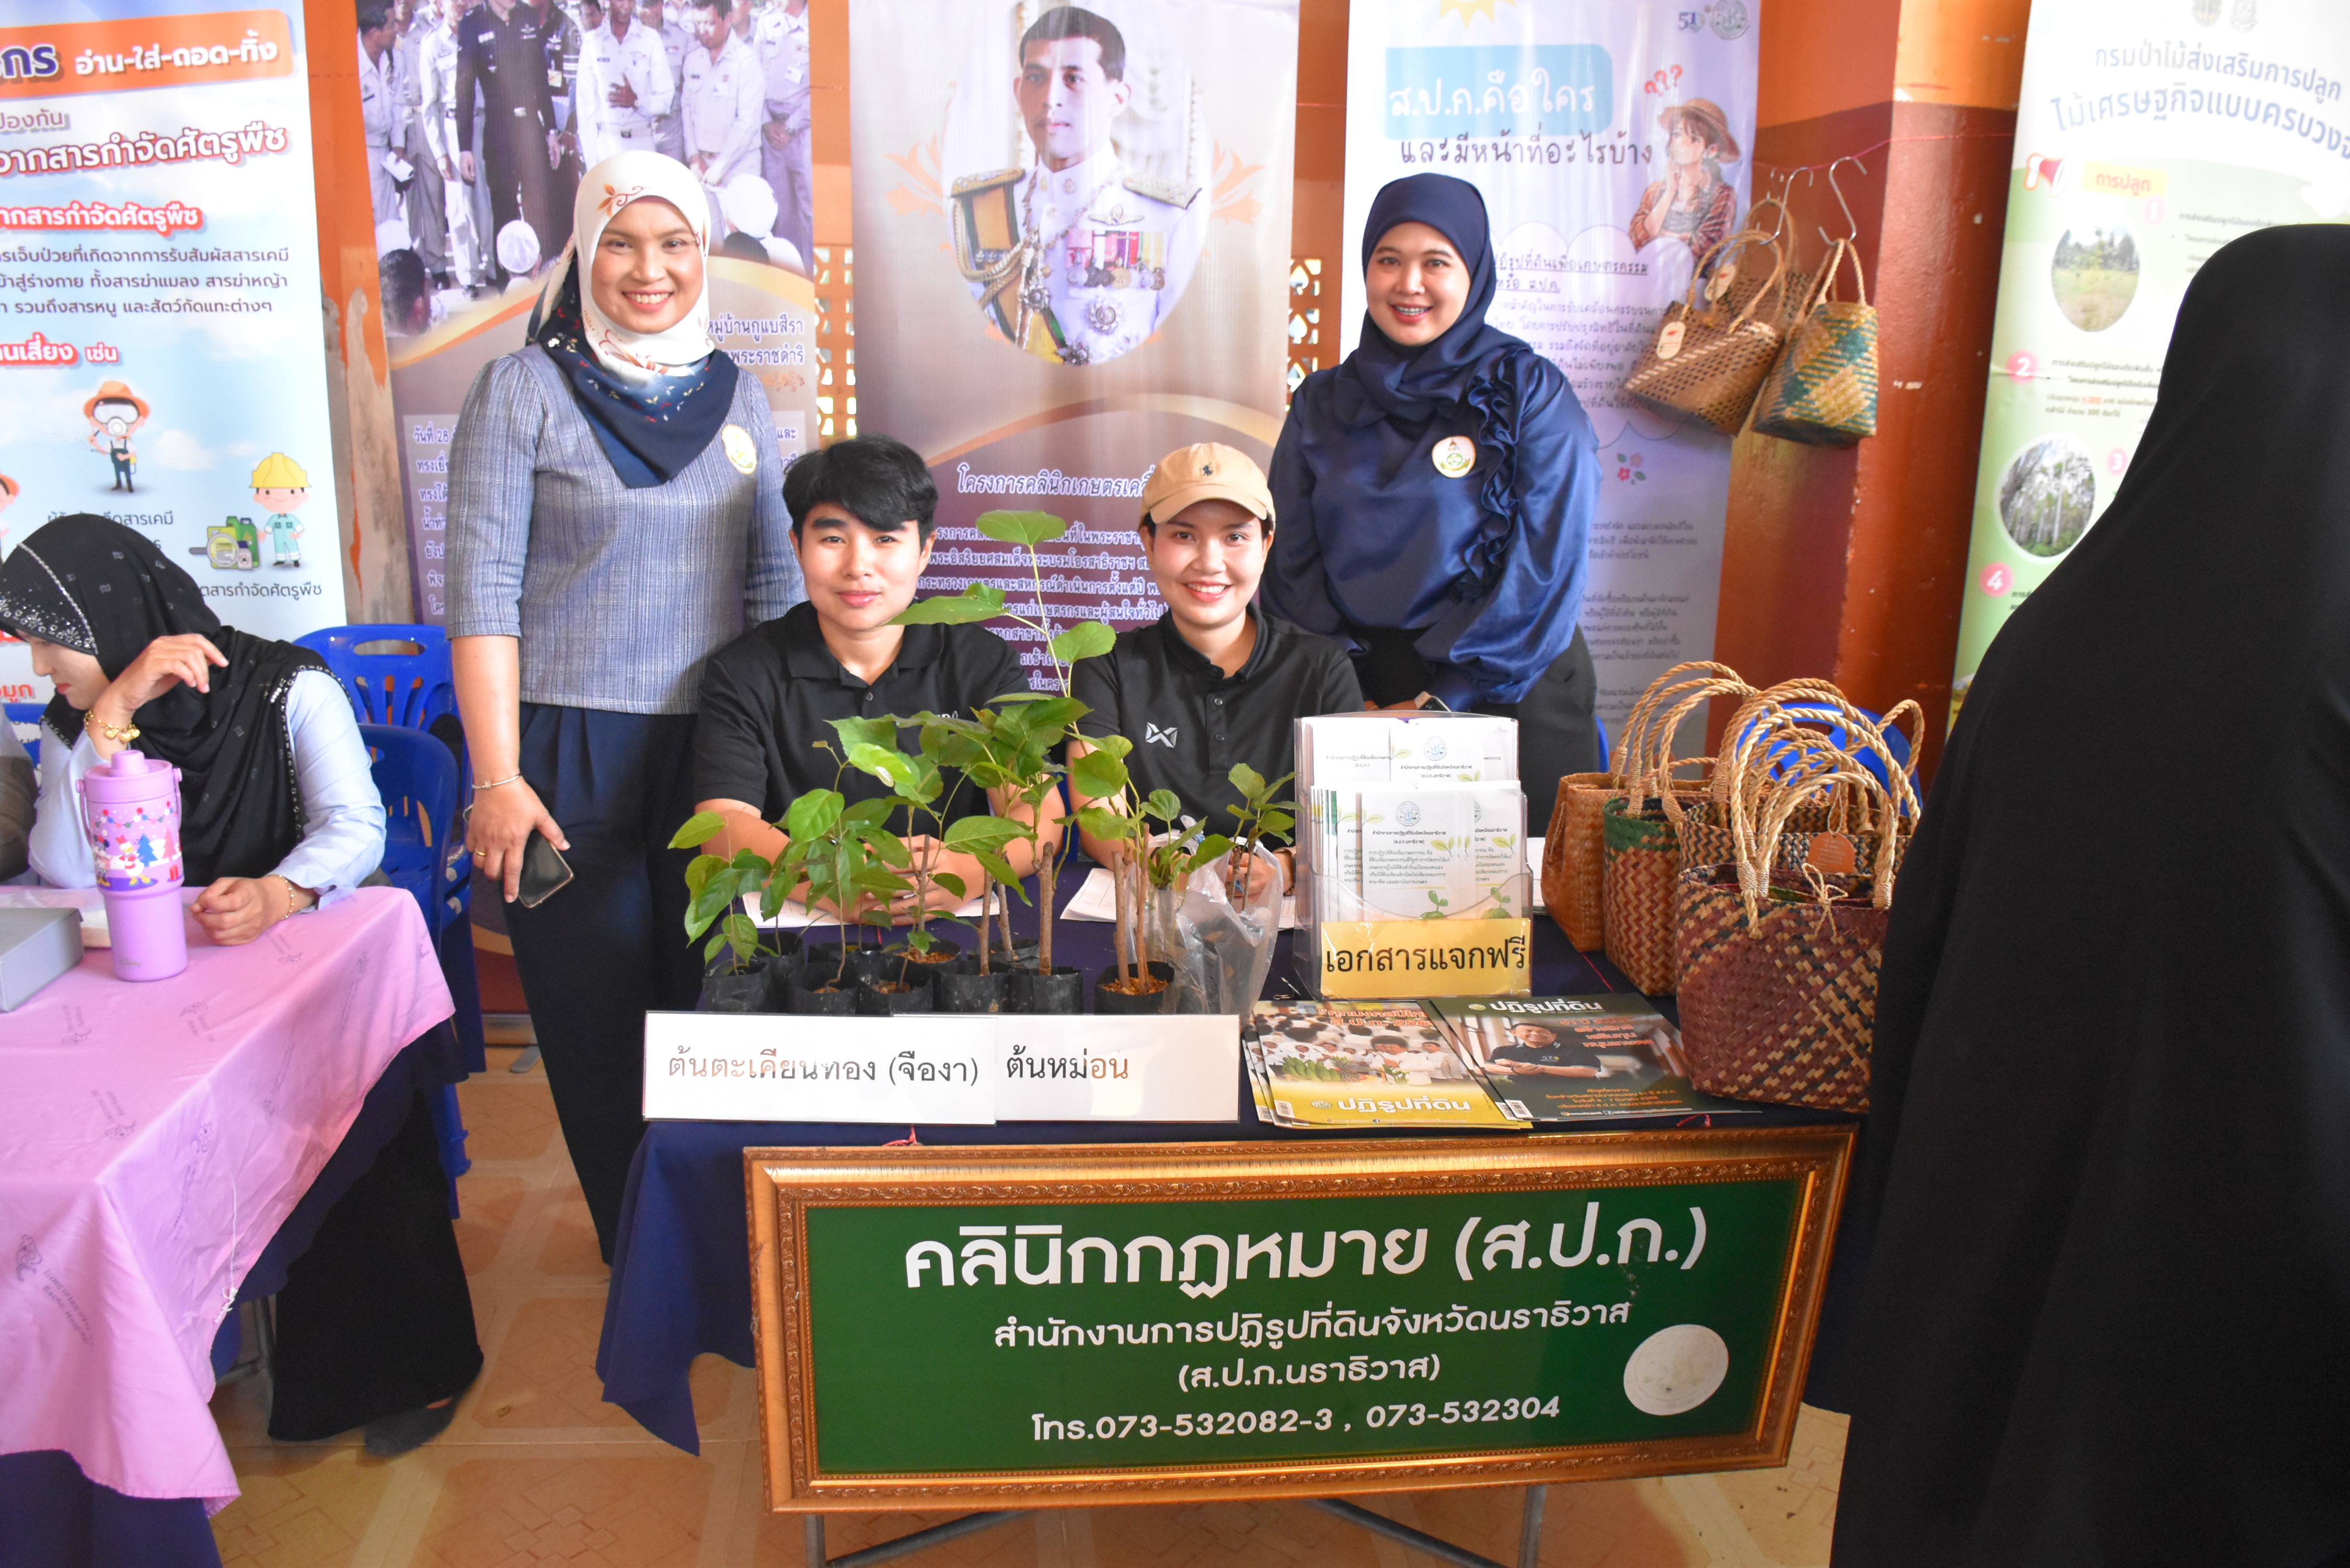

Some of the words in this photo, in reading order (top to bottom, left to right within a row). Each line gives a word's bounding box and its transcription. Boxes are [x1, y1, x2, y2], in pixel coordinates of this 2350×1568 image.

[75, 30, 278, 75] อ่าน-ใส่-ถอด-ทิ้ง
[2095, 38, 2342, 104] กรมป่าไม้ส่งเสริมการปลูก
[1400, 123, 1653, 165] และมีหน้าที่อะไรบ้าง
[2095, 171, 2151, 197] การปลูก
[0, 245, 289, 262] รเจ็บป่วยที่เกิดจากการรับสัมผัสสารเคมี
[90, 269, 199, 287] ทั้งสารฆ่าแมลง
[206, 272, 287, 289] สารฆ่าหญ้า
[15, 298, 117, 317] รวมถึงสารหนู
[123, 298, 272, 313] และสัตว์กัดแทะต่างๆ
[86, 343, 117, 361] เช่น
[726, 344, 804, 364] พระราชดำริ
[2015, 356, 2031, 377] 2
[437, 430, 449, 443] 28
[2111, 452, 2123, 470] 3
[1987, 570, 2003, 590] 4
[200, 581, 322, 601] ตสารกำจัดศัตรูพืช
[0, 684, 32, 702] มูก
[1326, 935, 1526, 973] เอกสารแจกฟรี
[1490, 998, 1604, 1014] ปฏิรูปที่ดิน
[668, 1044, 877, 1082] ต้นตะเคียนทอง
[888, 1050, 980, 1086] (จืองา)
[1007, 1045, 1129, 1081] ต้นหม่อน
[1337, 1096, 1471, 1113] ปฏิรูปที่ดิน
[1455, 1201, 1707, 1281] (ส.ป.ก.)
[994, 1300, 1631, 1350] สำนักงานการปฏิรูปที่ดินจังหวัดนราธิวาส
[1178, 1353, 1441, 1392] (ส.ป.ก.นราธิวาส)
[1031, 1408, 1333, 1442] โทร.073-532082-3
[1365, 1396, 1560, 1428] 073-532304
